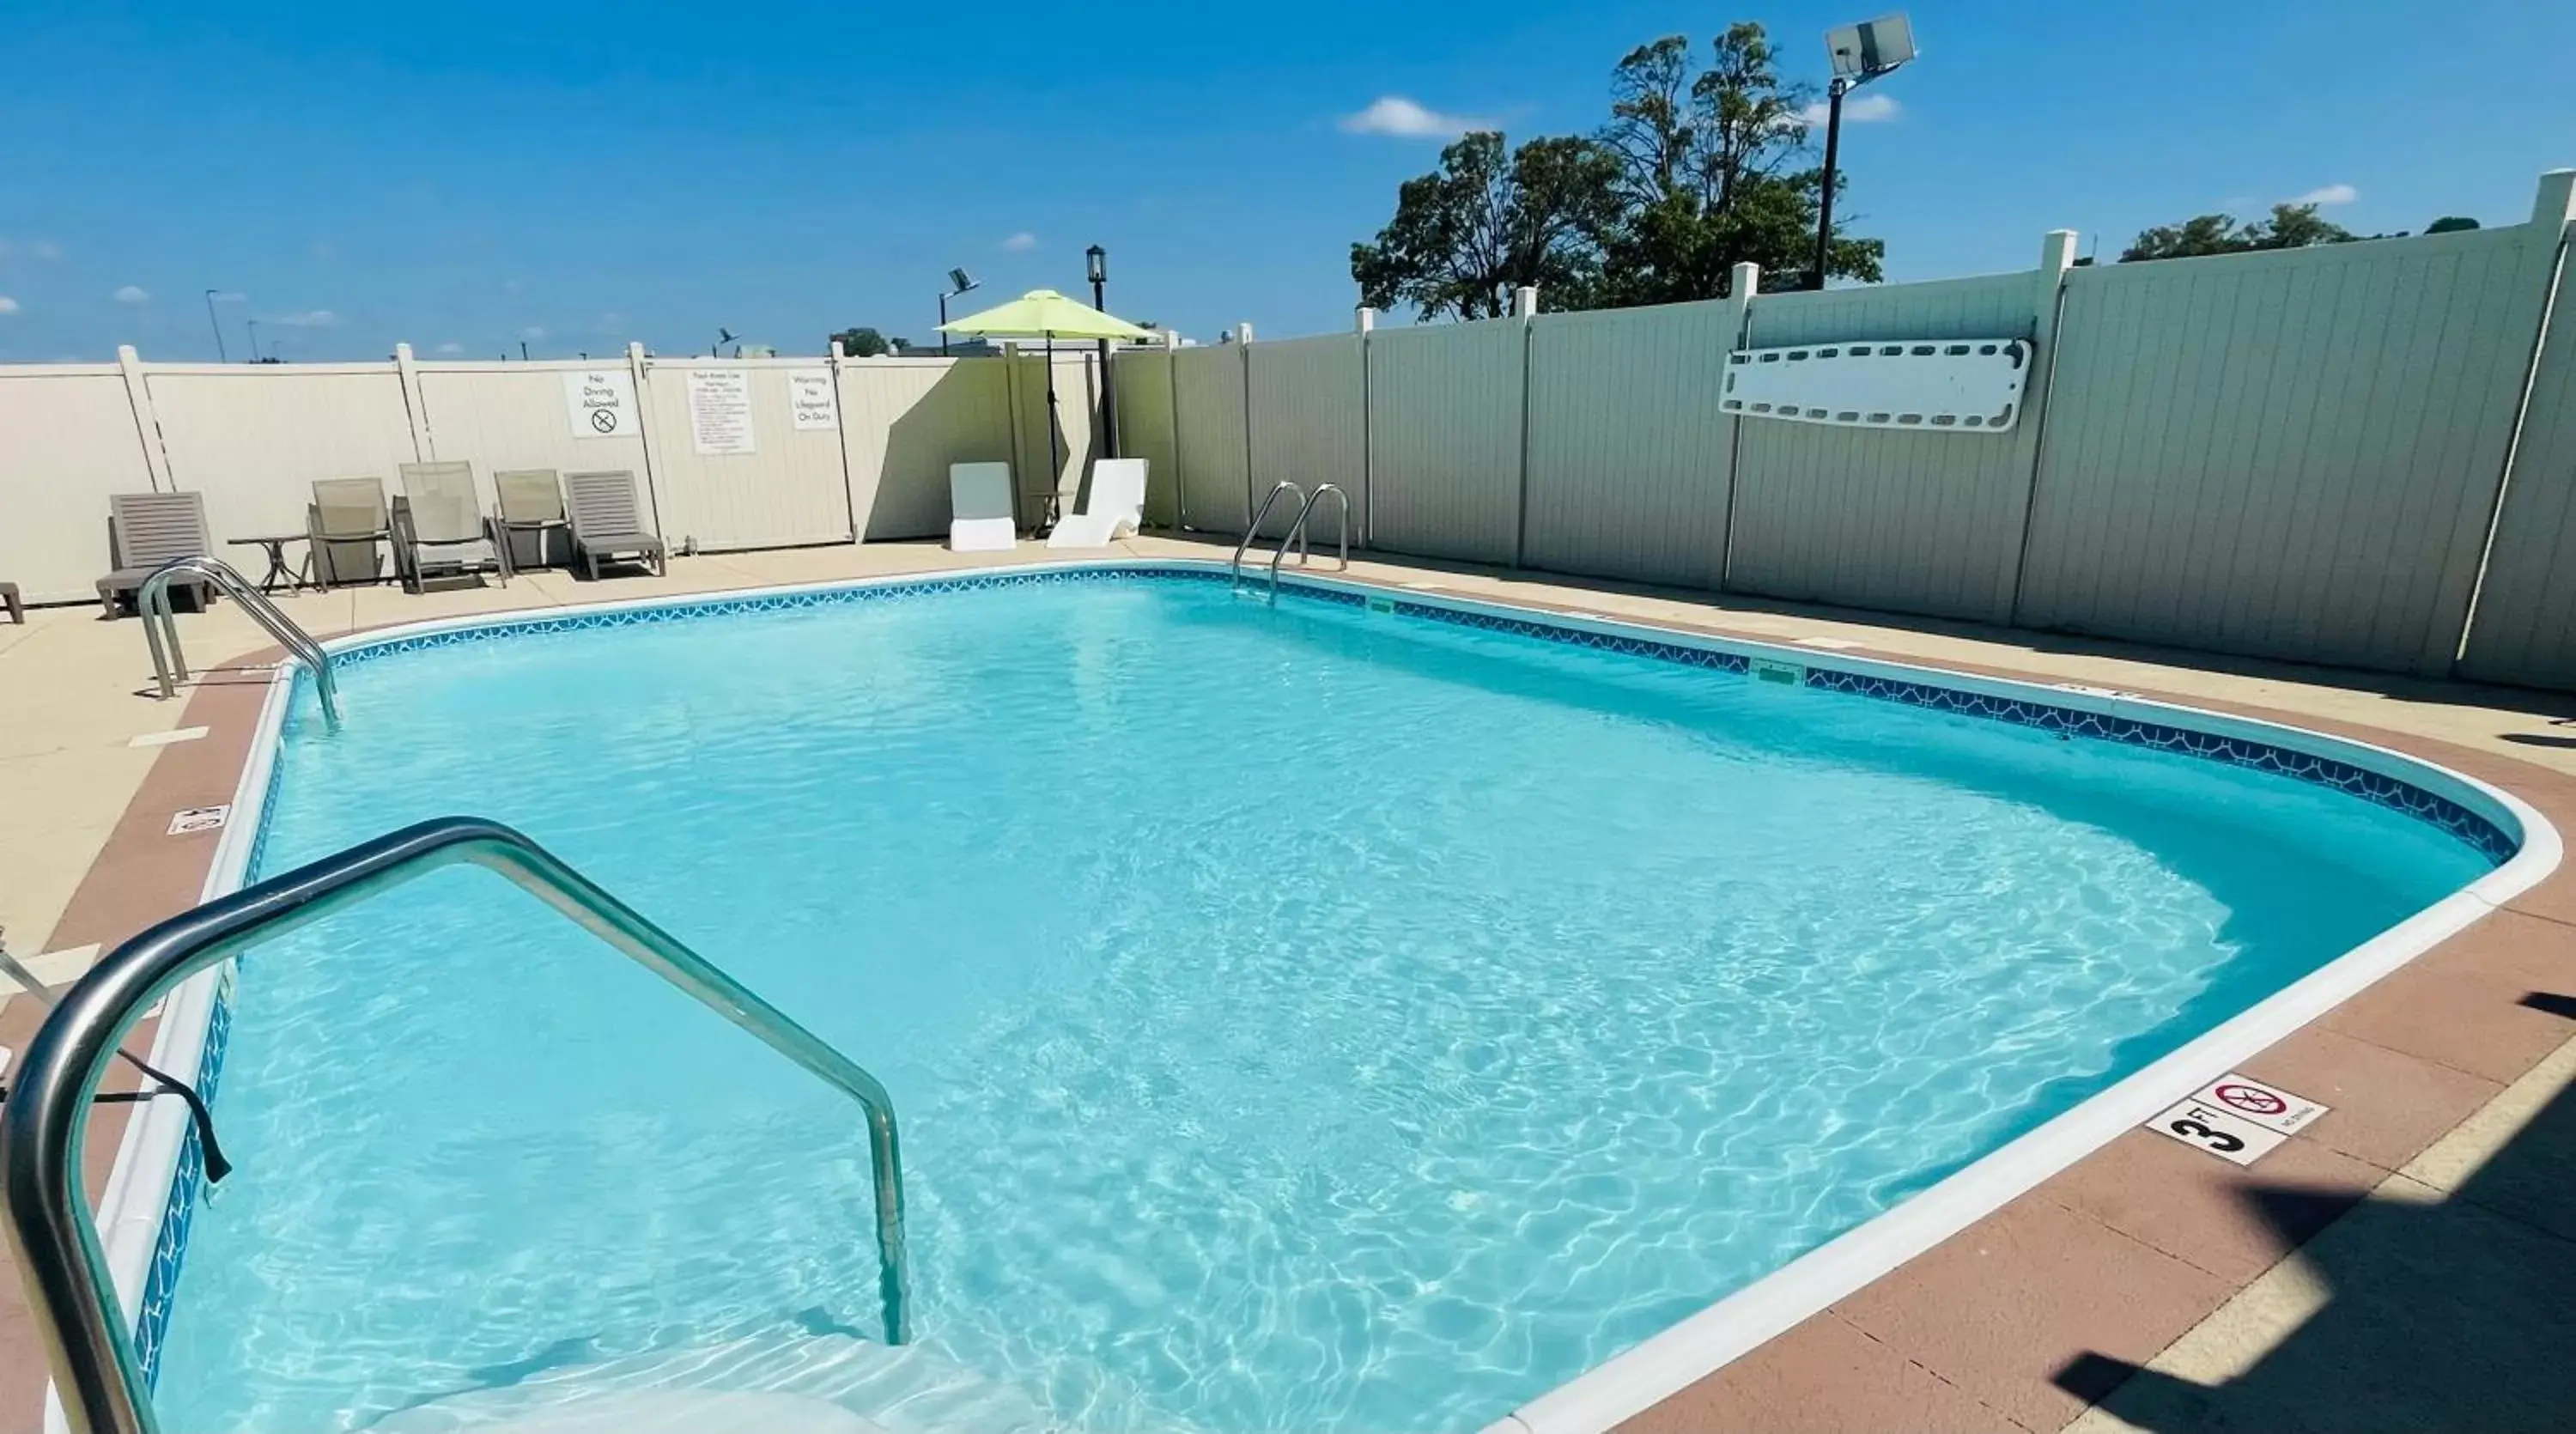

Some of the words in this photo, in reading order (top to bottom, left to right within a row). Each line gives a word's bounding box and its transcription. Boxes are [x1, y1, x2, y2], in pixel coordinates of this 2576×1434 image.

[588, 374, 605, 384] No
[584, 386, 615, 398] Diving
[583, 398, 619, 408] Allowed
[2187, 1107, 2219, 1124] FT
[2171, 1120, 2245, 1152] 3
